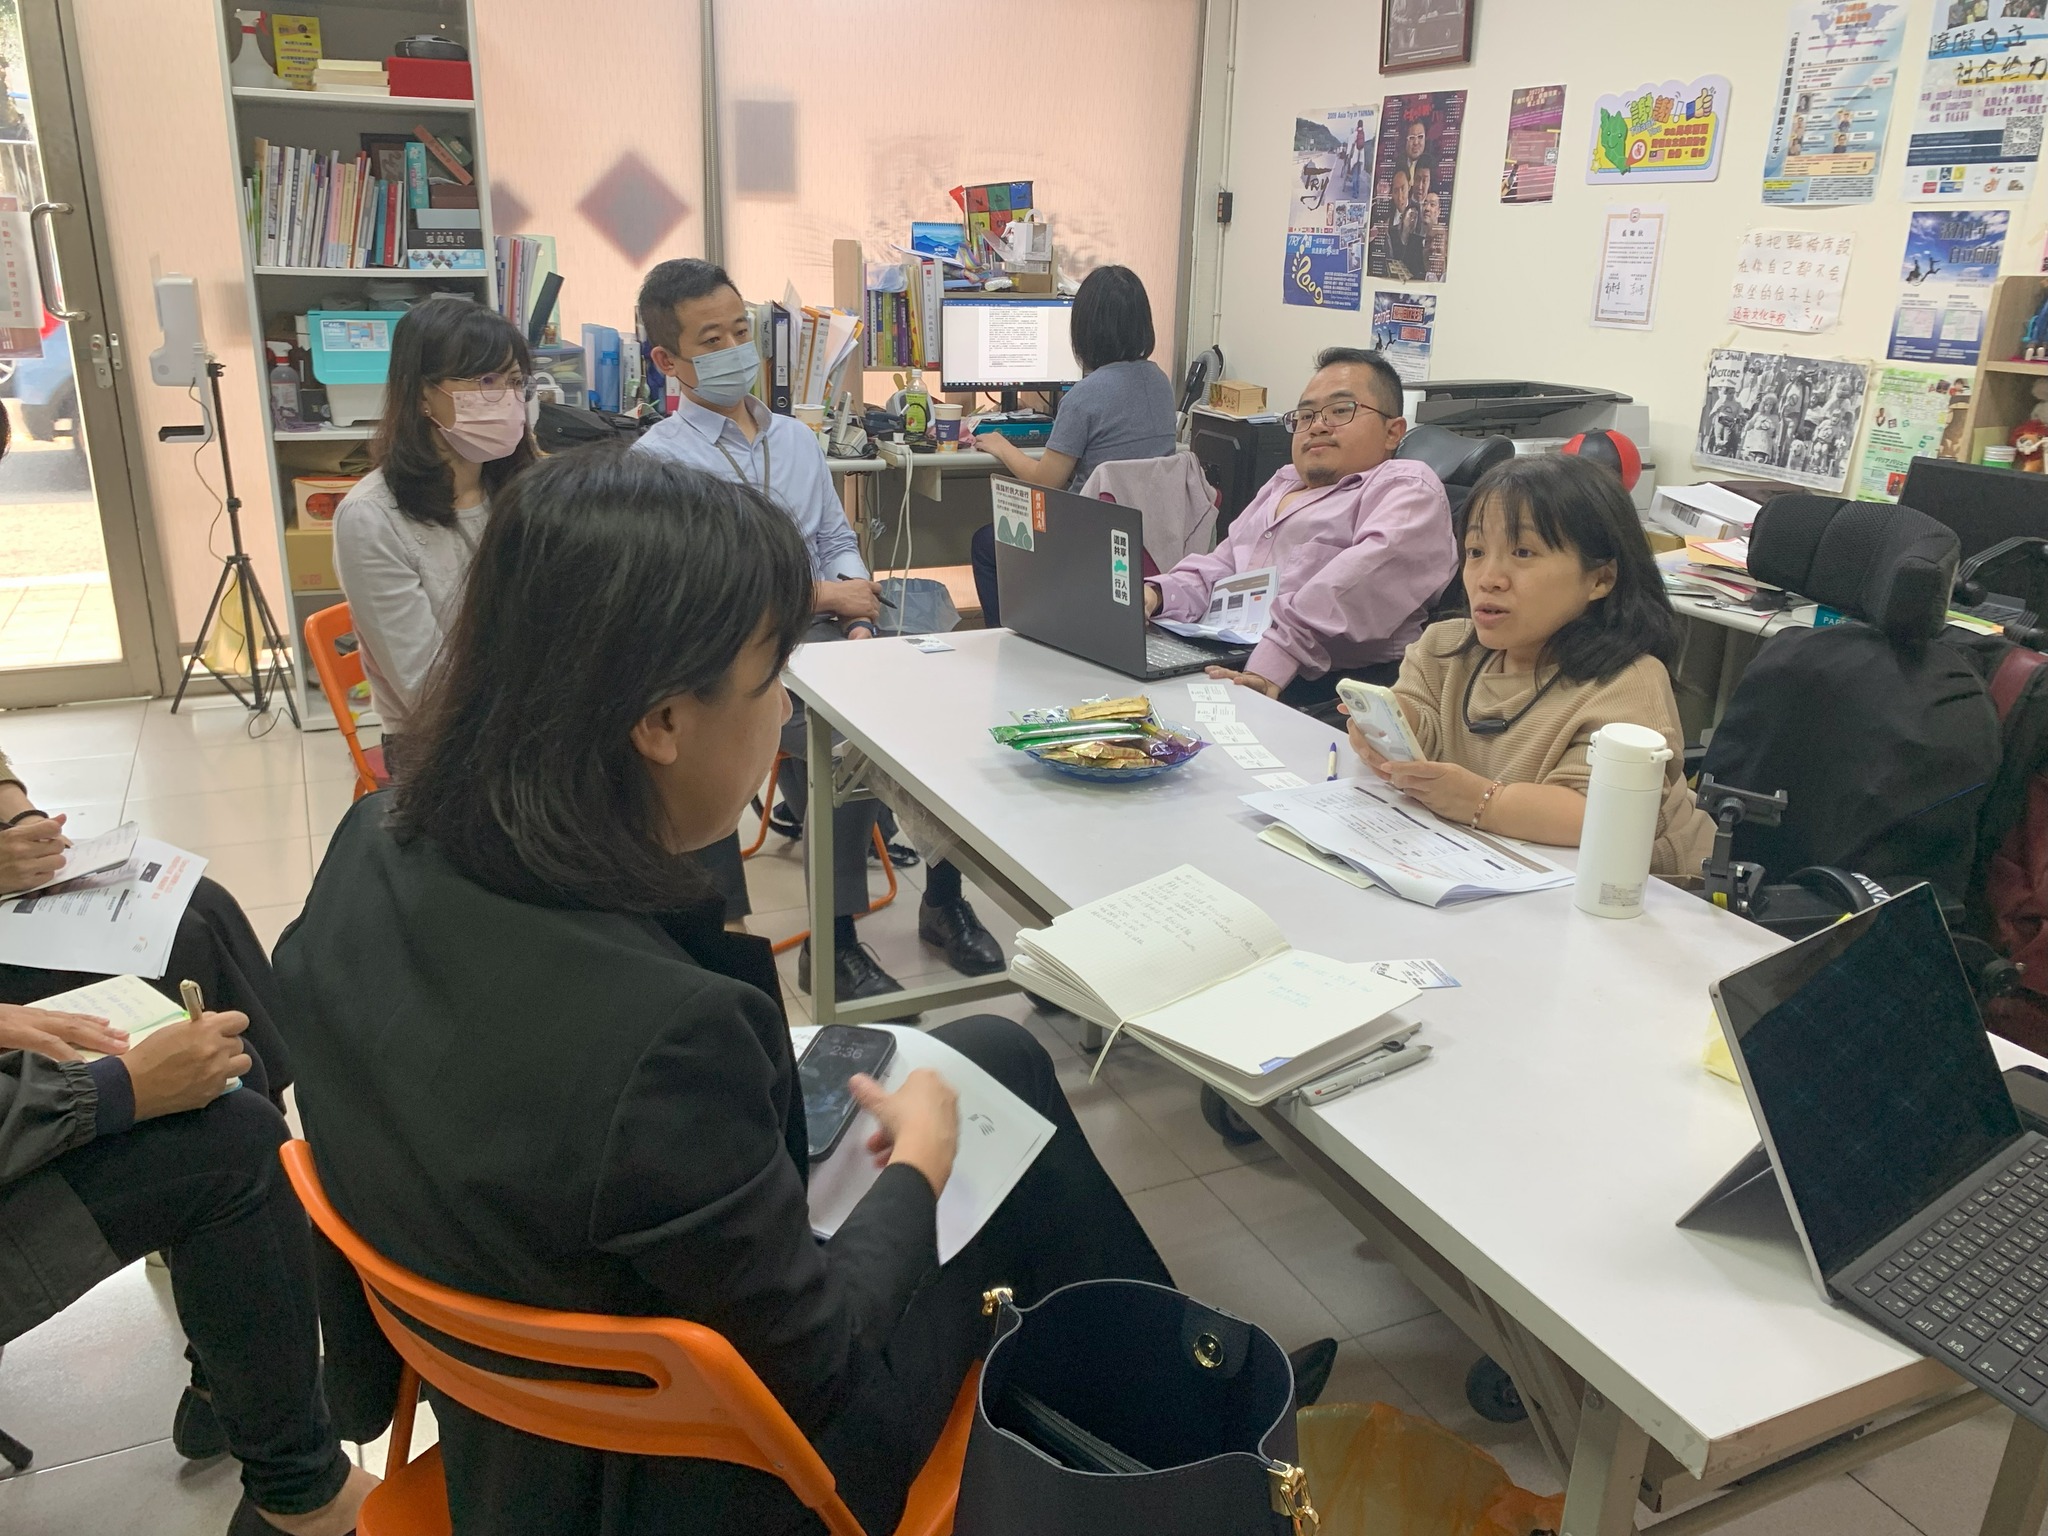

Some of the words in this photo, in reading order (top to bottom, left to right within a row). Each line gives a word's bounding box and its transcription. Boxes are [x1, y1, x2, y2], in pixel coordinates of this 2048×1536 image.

[1711, 366, 1740, 378] Overcome
[1114, 534, 1126, 547] 道路
[1114, 546, 1126, 557] 共享
[1115, 578, 1127, 590] 行人
[829, 1045, 864, 1060] 2:36
